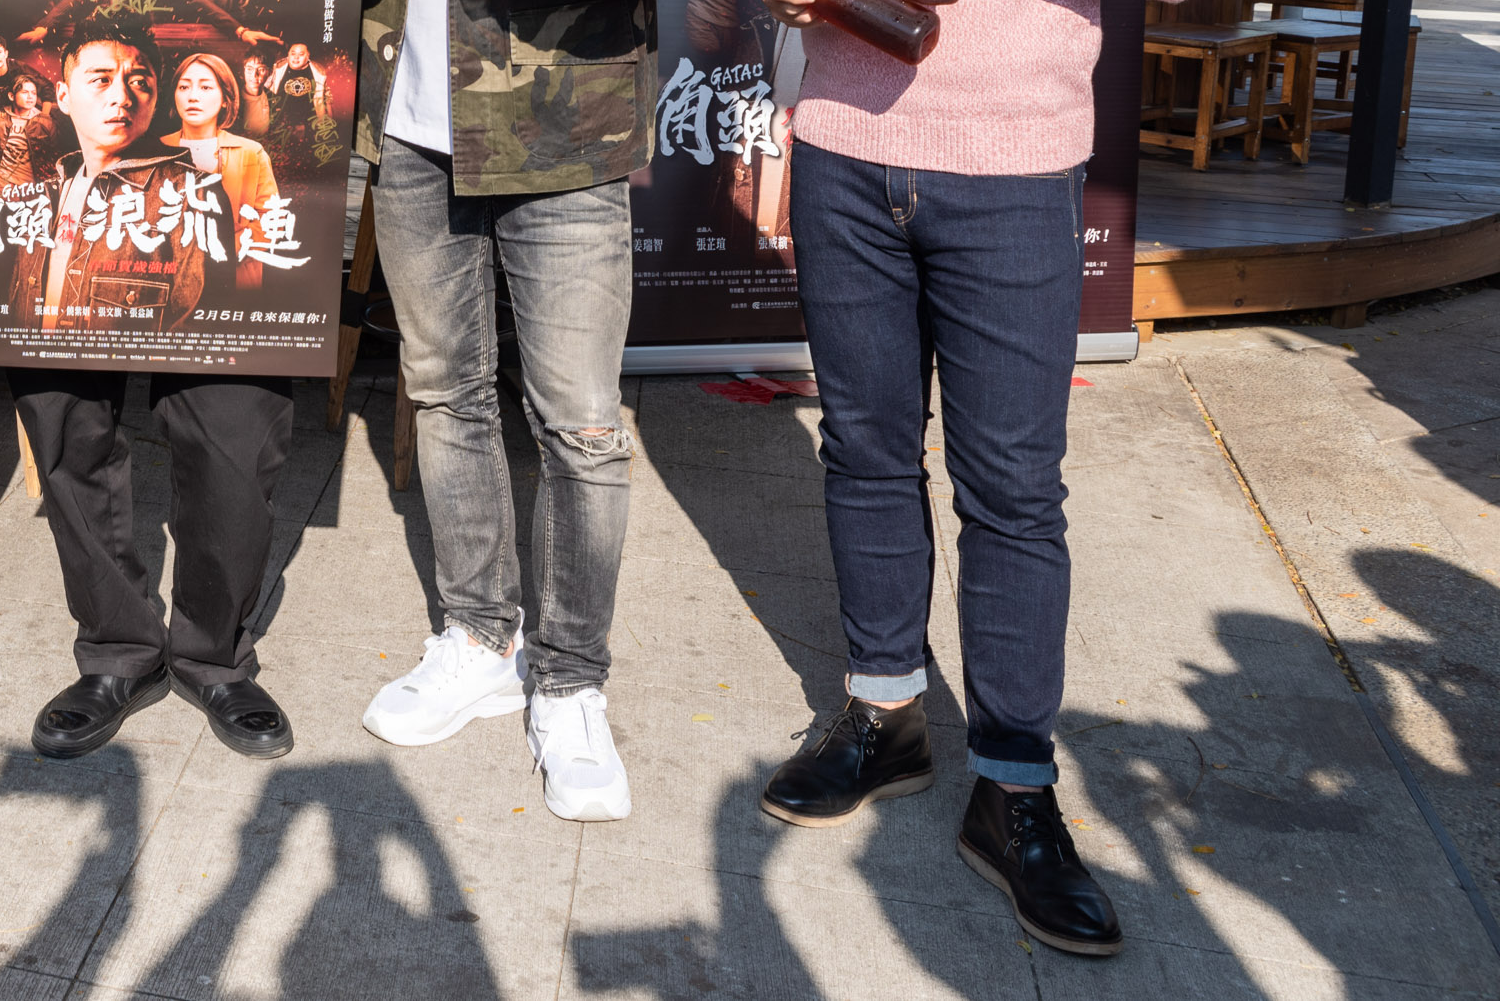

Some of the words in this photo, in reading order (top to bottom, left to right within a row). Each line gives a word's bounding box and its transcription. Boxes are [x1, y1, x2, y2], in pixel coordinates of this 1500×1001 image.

[710, 63, 764, 91] GATAO
[655, 57, 780, 165] 角頭
[2, 182, 45, 202] GATAO
[194, 310, 244, 321] 2月5日
